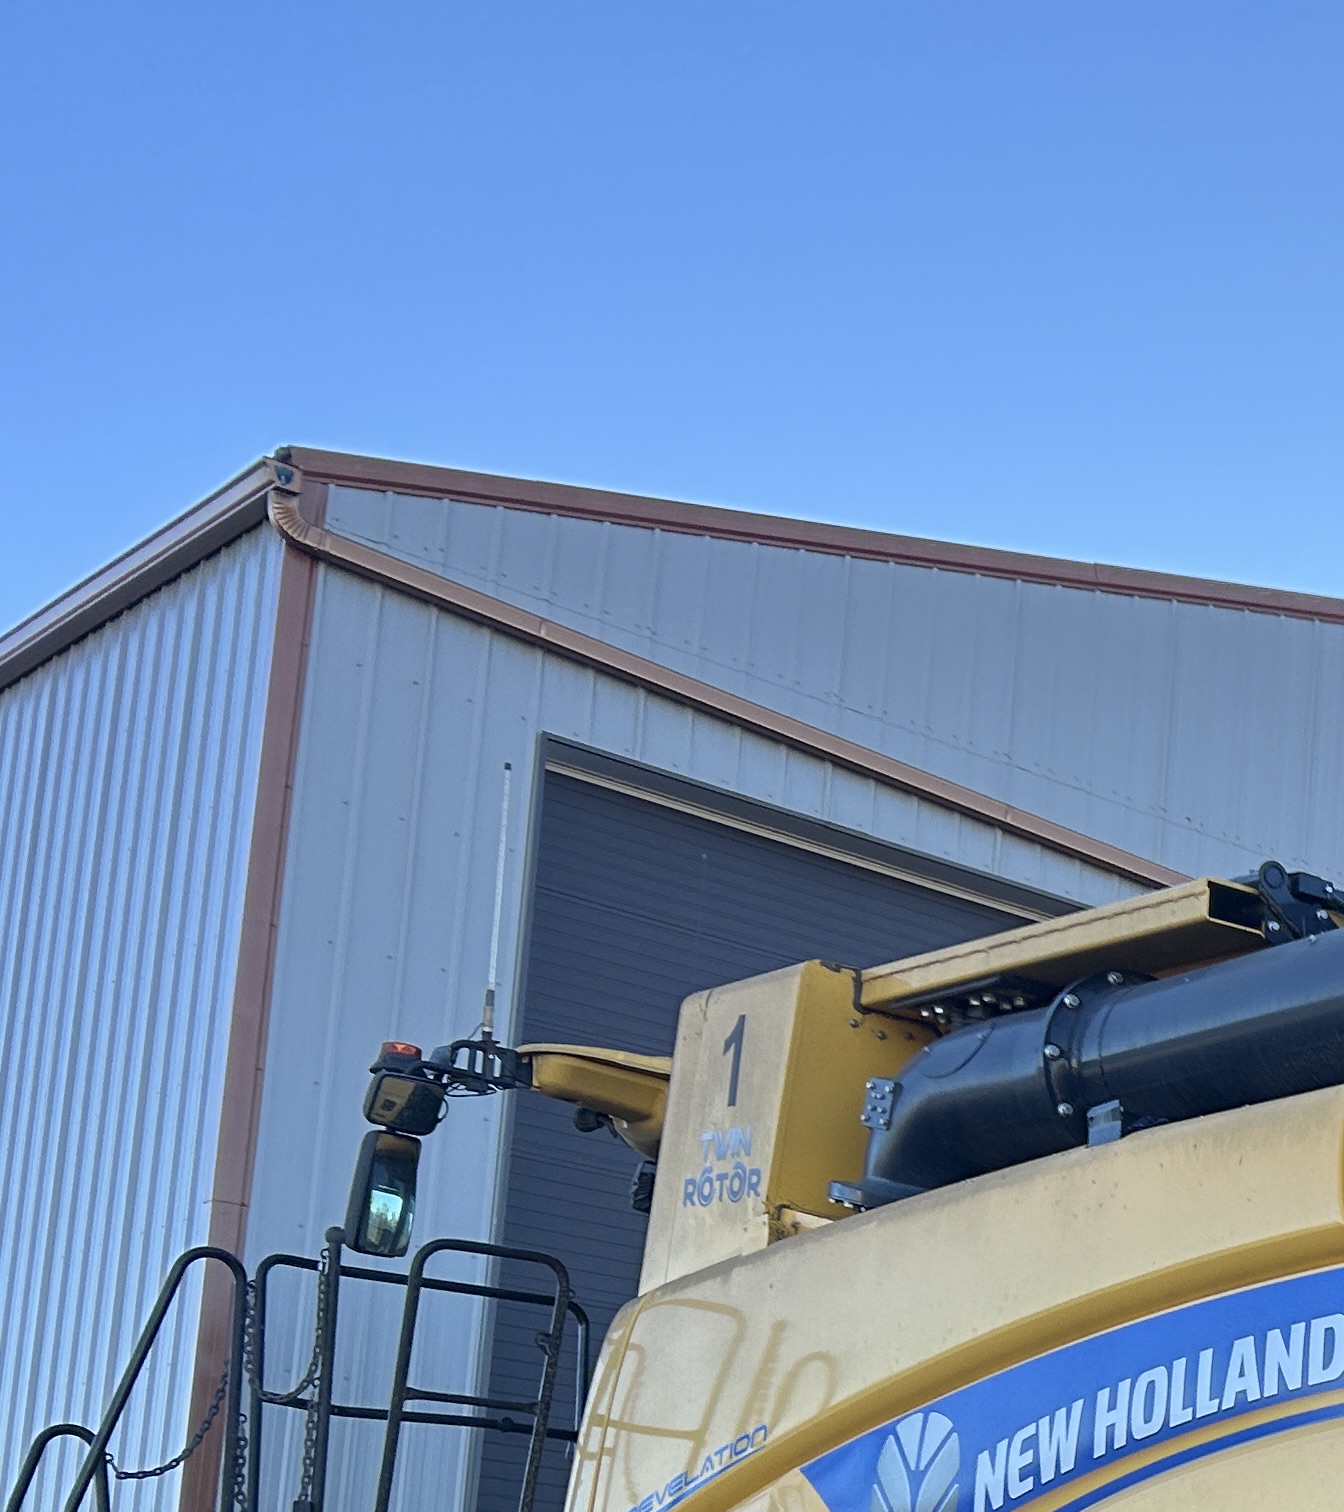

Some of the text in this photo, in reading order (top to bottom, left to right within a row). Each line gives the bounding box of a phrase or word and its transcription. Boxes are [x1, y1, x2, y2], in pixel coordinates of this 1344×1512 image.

[722, 1014, 746, 1107] 1
[700, 1125, 752, 1161] TWIN
[683, 1161, 761, 1207] ROTOR
